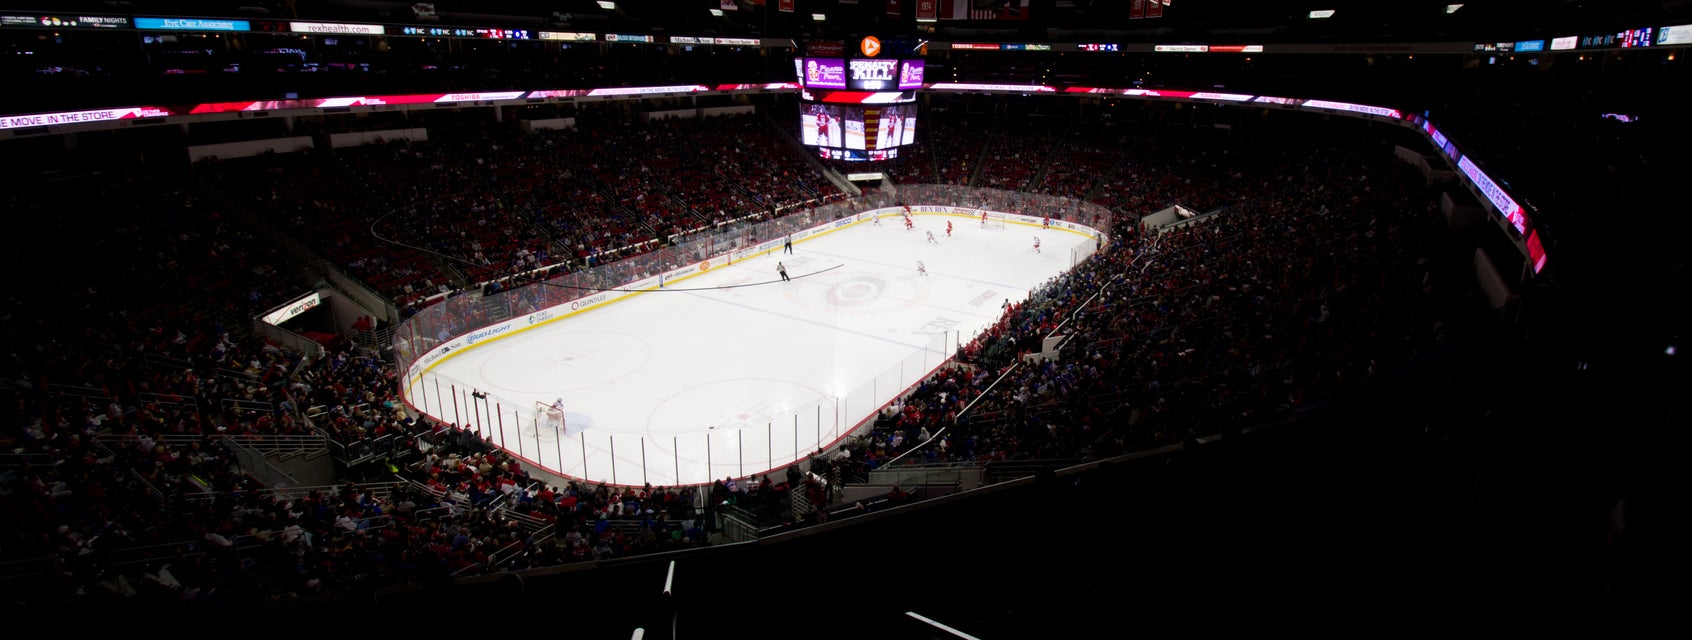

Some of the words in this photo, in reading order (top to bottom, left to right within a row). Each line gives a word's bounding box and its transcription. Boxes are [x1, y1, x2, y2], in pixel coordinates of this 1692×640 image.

[164, 18, 179, 27] Eye
[179, 19, 197, 27] Care
[197, 20, 234, 29] Associates
[308, 23, 369, 33] rexhealth.com
[850, 61, 896, 70] PENALTY
[853, 69, 892, 80] KILL
[11, 116, 45, 127] MOVE.
[47, 115, 59, 124] IN
[60, 113, 82, 123] THE
[83, 111, 118, 120] STORE.
[835, 217, 852, 227] GEICO
[290, 298, 316, 315] verizon
[469, 333, 487, 342] BUD
[488, 324, 511, 336] LIGHT
[423, 351, 441, 364] Michael
